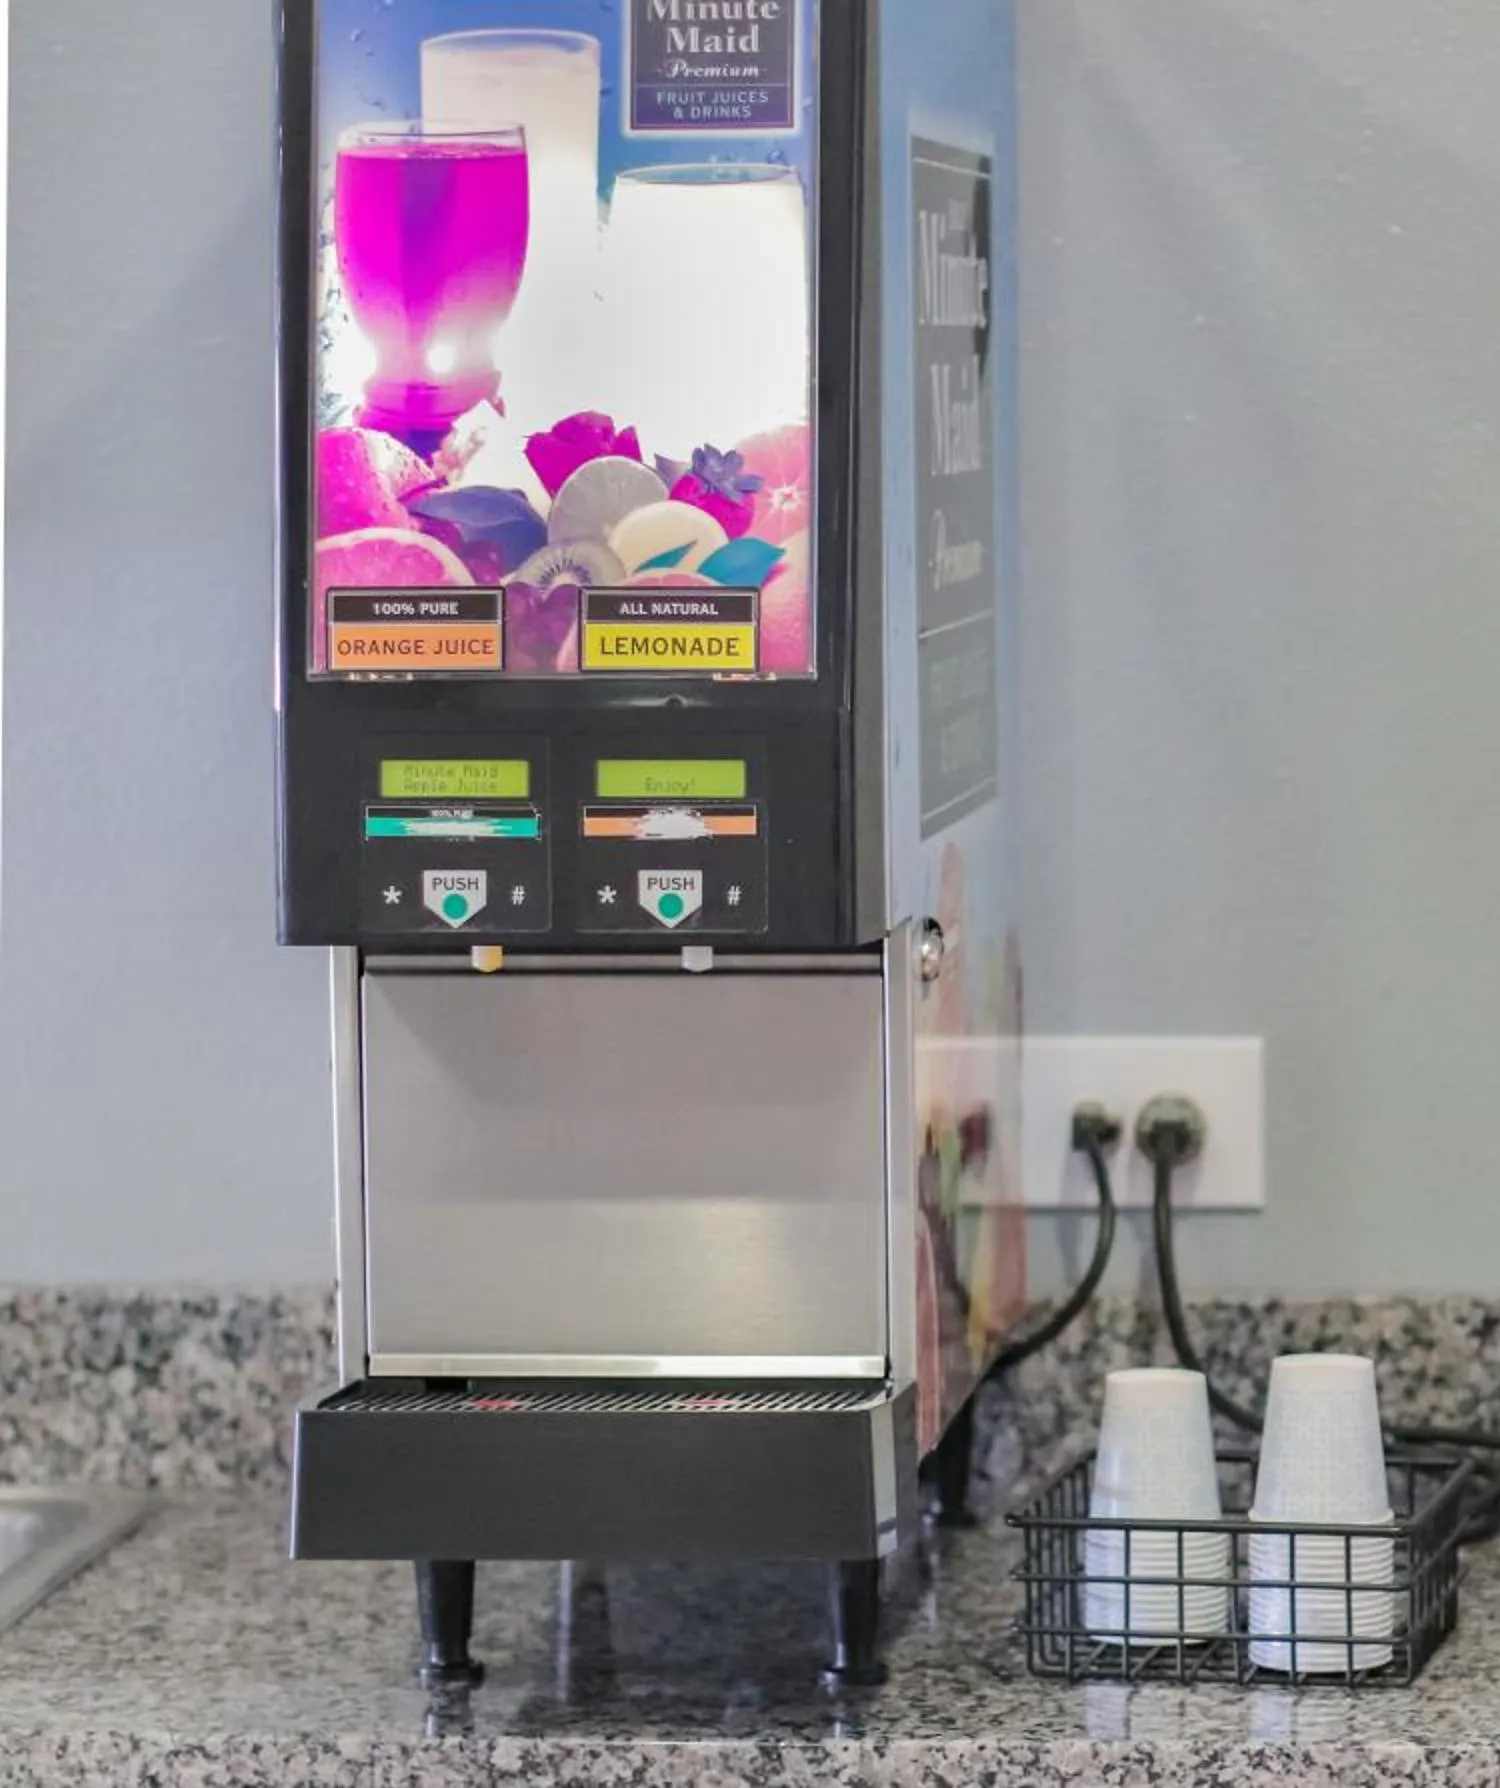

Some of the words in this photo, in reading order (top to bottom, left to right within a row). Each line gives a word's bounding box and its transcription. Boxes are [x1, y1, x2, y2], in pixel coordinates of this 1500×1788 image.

[647, 0, 781, 21] Minute
[666, 24, 760, 53] Maid
[664, 57, 759, 78] Premium
[656, 91, 705, 105] FRUIT
[711, 91, 769, 104] JUICES
[673, 108, 683, 119] &
[690, 105, 752, 119] DRINKS
[930, 354, 980, 476] Maid
[373, 602, 415, 615] 100%
[420, 602, 459, 615] PURE
[620, 603, 648, 615] ALL
[652, 603, 719, 615] NATURAL
[337, 639, 424, 656] ORANGE
[433, 639, 494, 655] JUICE
[600, 636, 740, 656] LEMONADE
[432, 877, 479, 891] PUSH
[647, 877, 694, 891] PUSH
